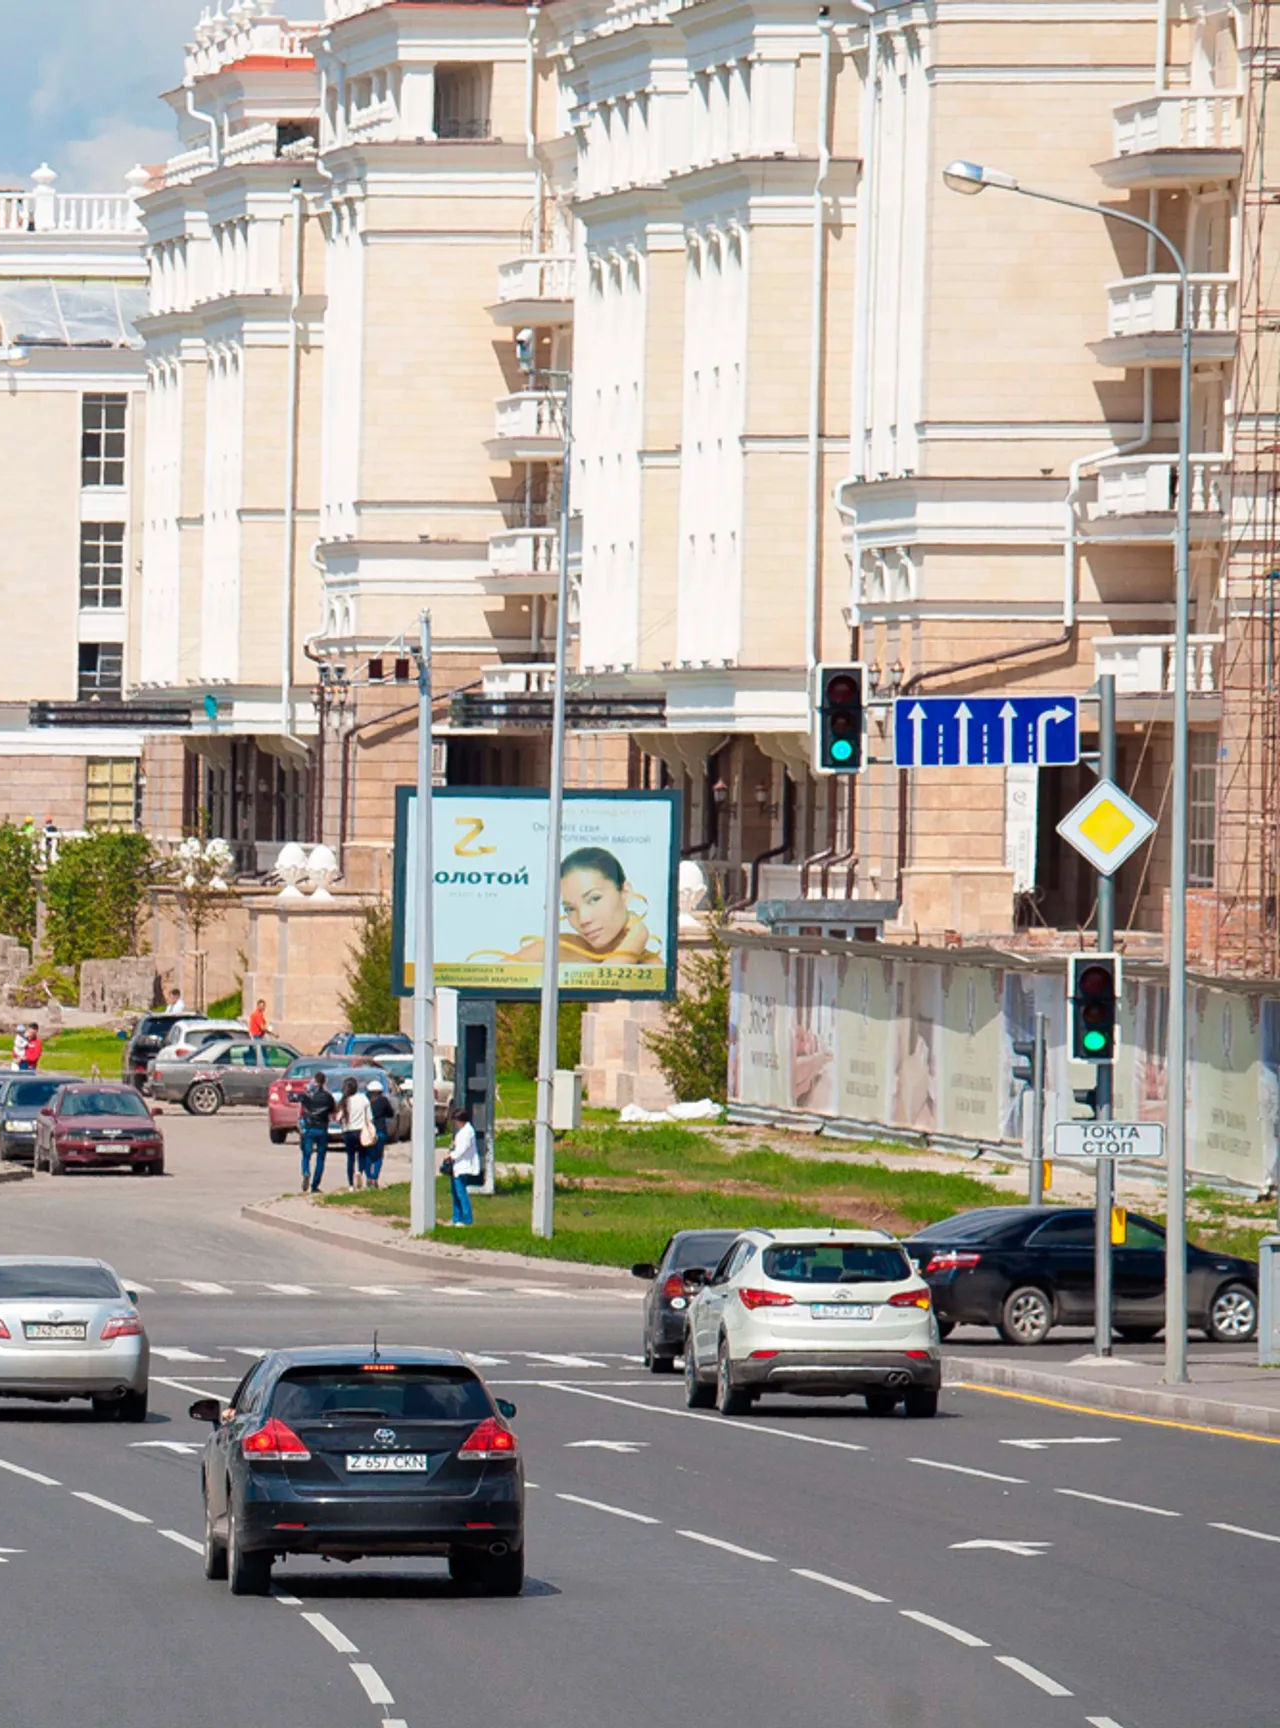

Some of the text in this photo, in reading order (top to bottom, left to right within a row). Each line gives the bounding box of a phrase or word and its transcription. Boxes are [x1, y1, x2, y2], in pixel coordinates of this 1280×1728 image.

[431, 864, 530, 885] олотой
[598, 967, 653, 979] 33-22-22
[1081, 1126, 1140, 1140] ТОҚТА
[1082, 1141, 1134, 1154] СТОП
[351, 1455, 425, 1468] Z 657 CKN
